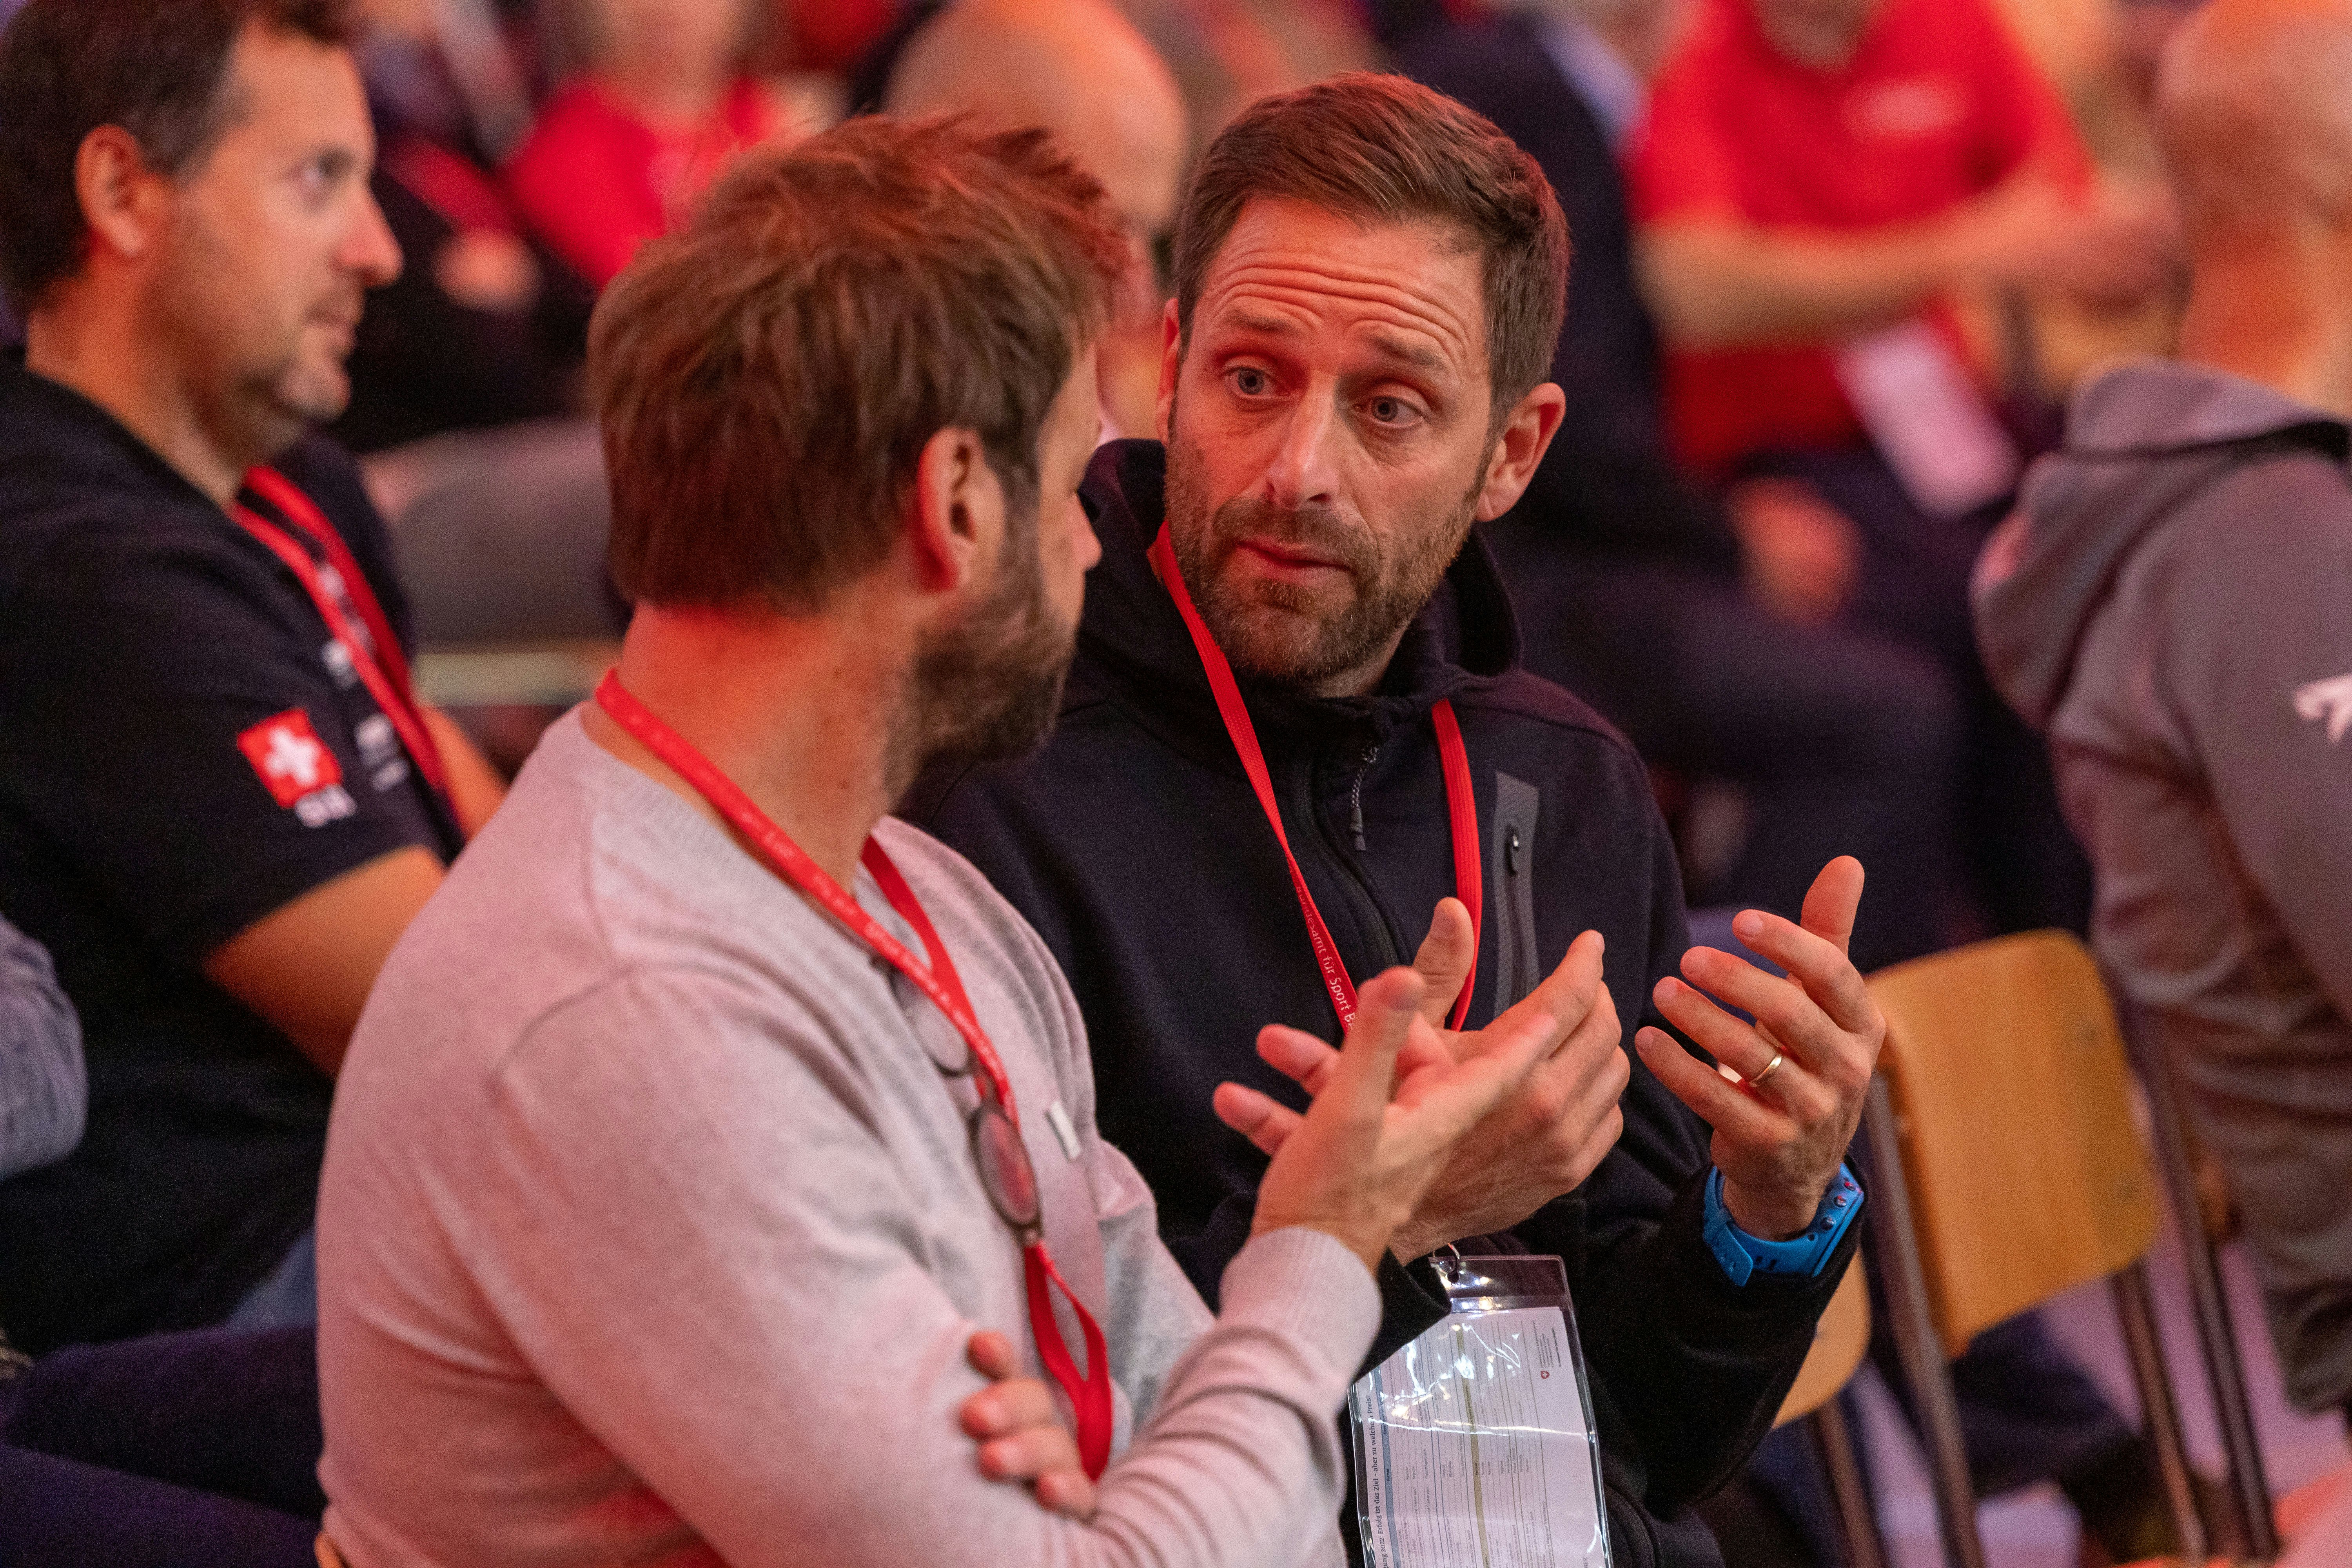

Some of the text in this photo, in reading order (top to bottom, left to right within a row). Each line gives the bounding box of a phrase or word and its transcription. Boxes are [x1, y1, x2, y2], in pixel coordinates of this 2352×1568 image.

[1323, 955, 1335, 973] für
[1329, 976, 1350, 1010] Sport
[1371, 1447, 1377, 1455] zu
